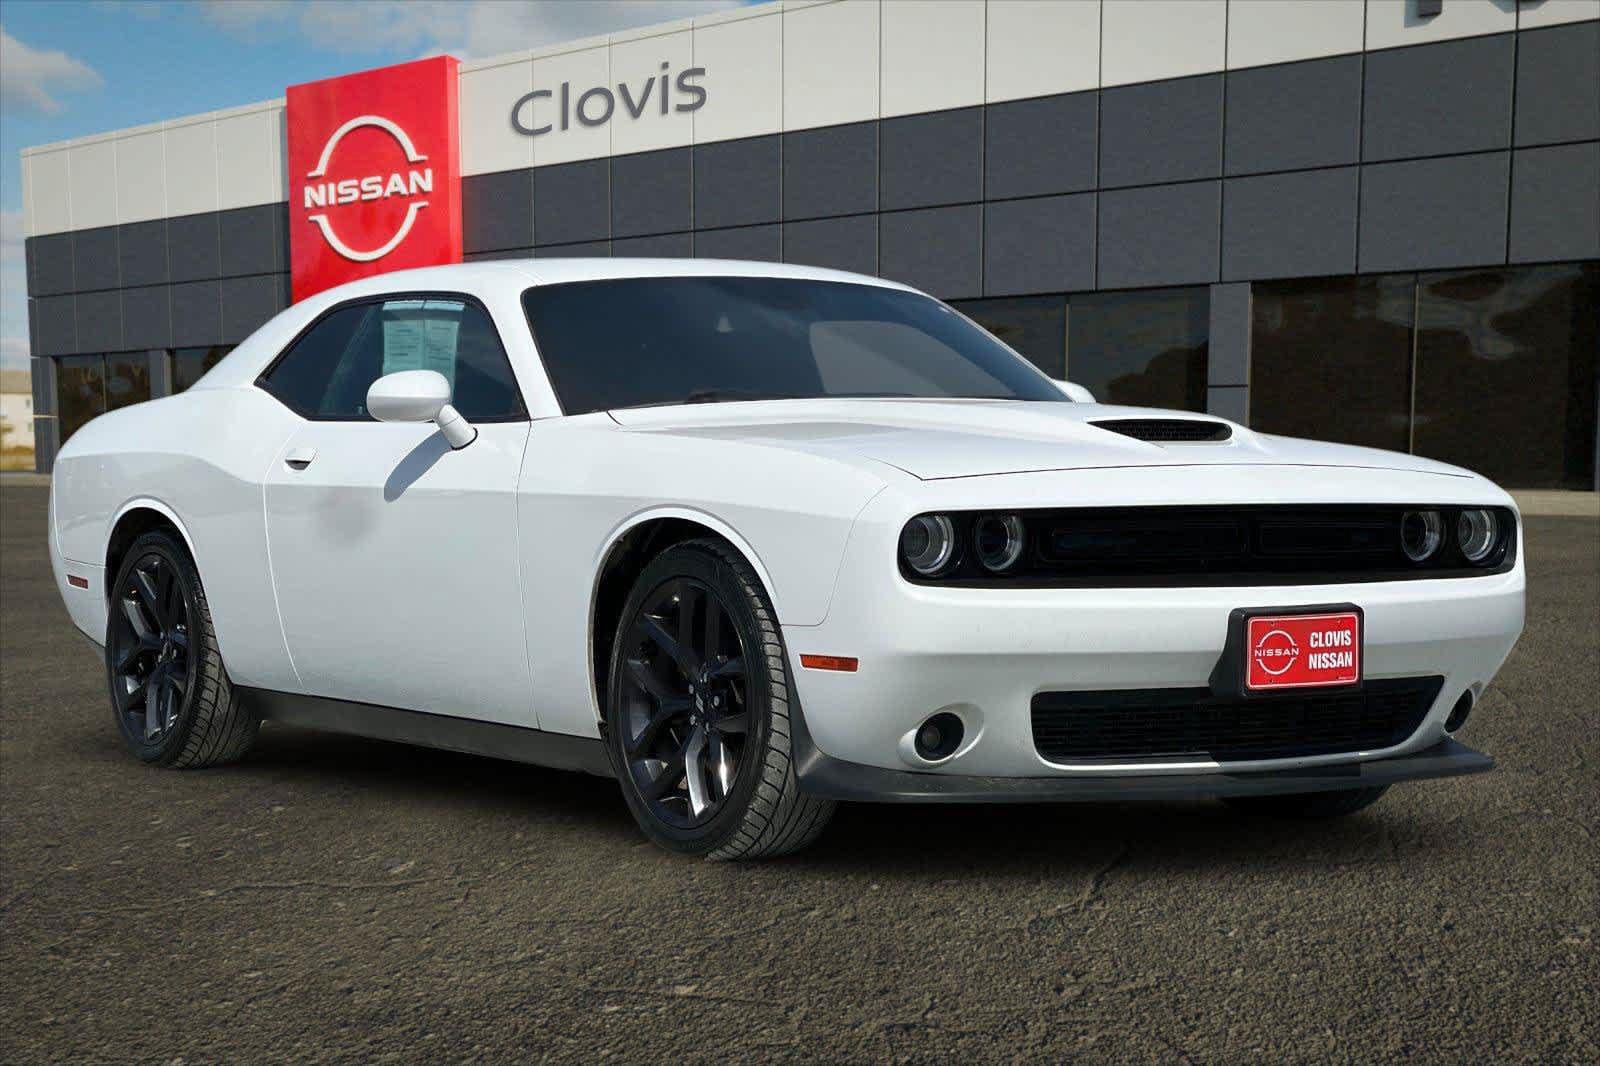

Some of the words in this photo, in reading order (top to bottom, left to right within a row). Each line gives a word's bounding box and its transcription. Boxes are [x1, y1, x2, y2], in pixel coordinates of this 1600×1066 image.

[511, 62, 707, 136] Clovis
[304, 169, 433, 208] NISSAN
[1310, 630, 1351, 648] CLOVIS
[1255, 648, 1299, 656] NISSAN
[1309, 652, 1352, 669] NISSAN
